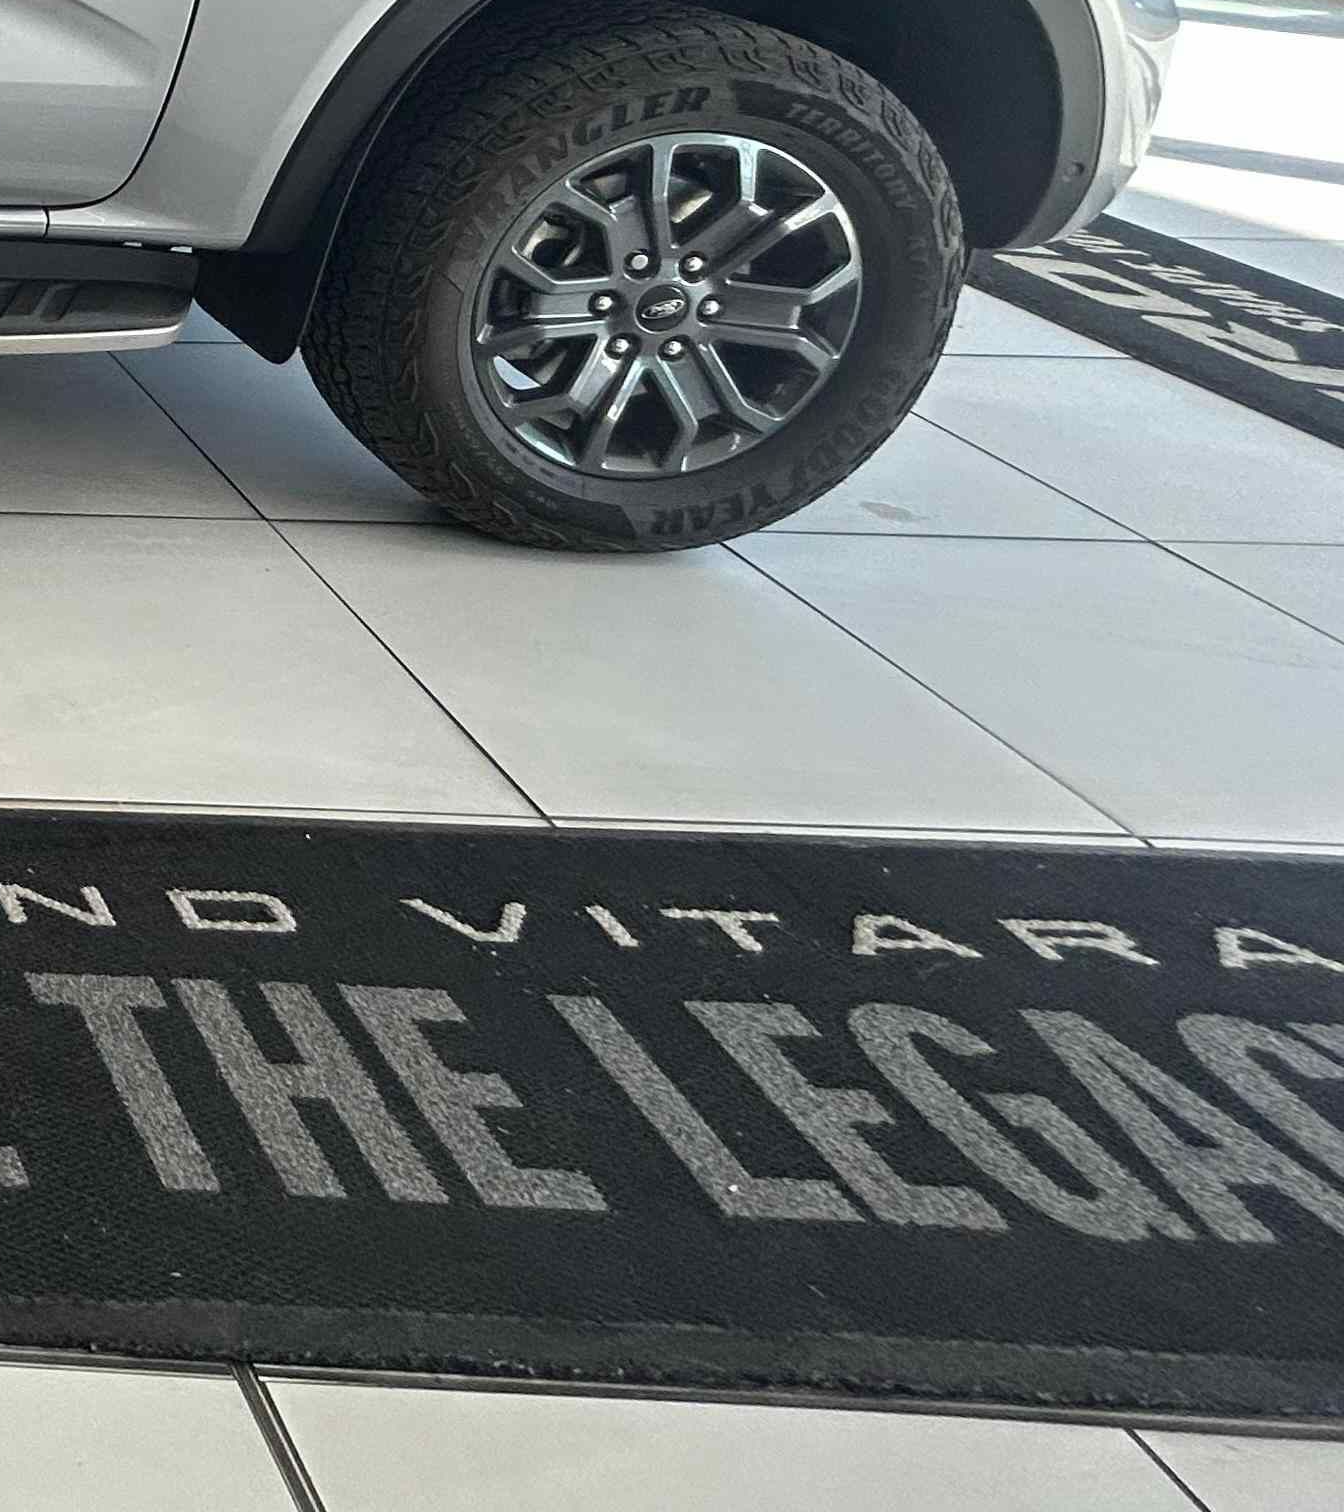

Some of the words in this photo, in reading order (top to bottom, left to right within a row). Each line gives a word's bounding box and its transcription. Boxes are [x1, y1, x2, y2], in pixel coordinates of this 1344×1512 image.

[786, 101, 918, 210] TERRITORY
[402, 897, 1344, 973] VITARA
[23, 971, 609, 1212] THE
[546, 992, 1344, 1244] LEGAC
